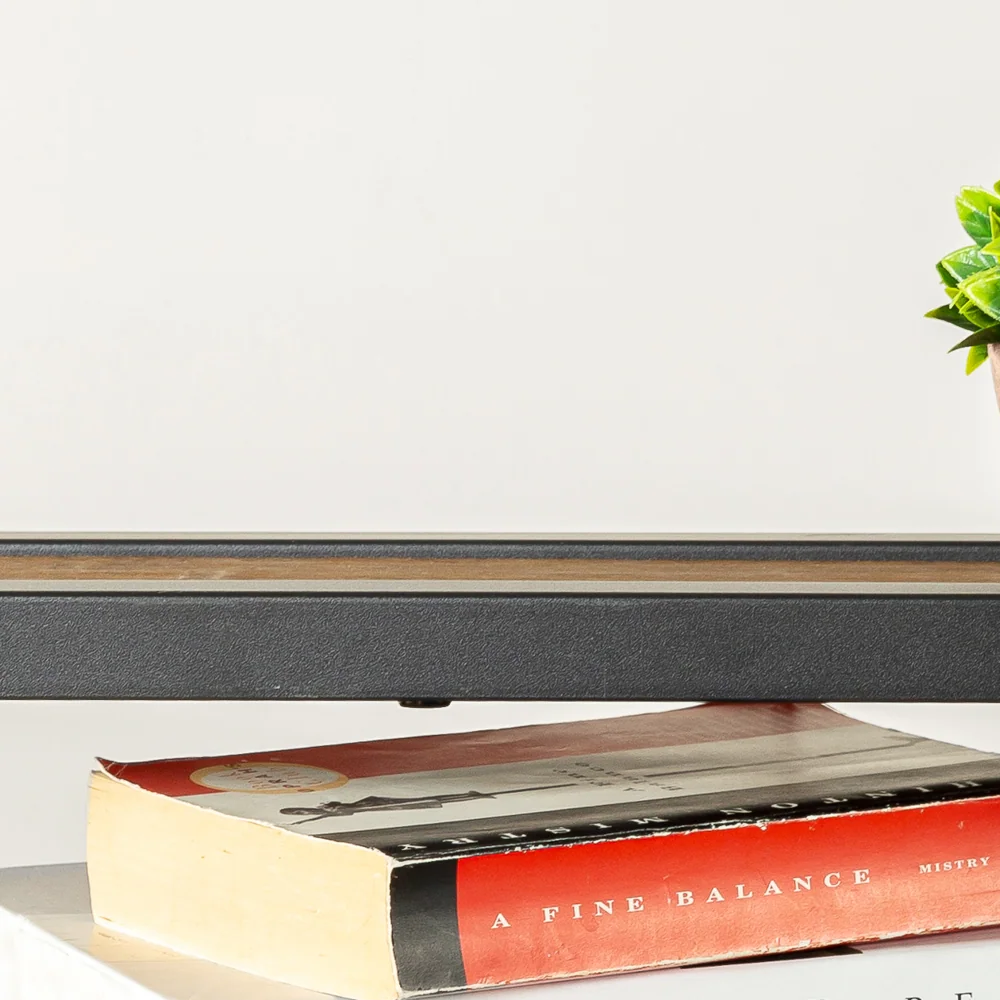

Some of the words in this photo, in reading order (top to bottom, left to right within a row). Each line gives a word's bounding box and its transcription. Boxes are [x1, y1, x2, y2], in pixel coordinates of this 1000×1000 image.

[400, 816, 669, 851] MISTRY
[490, 912, 511, 931] A
[541, 895, 646, 923] FINE
[675, 868, 872, 908] BALANCE
[917, 855, 991, 875] MISTRY
